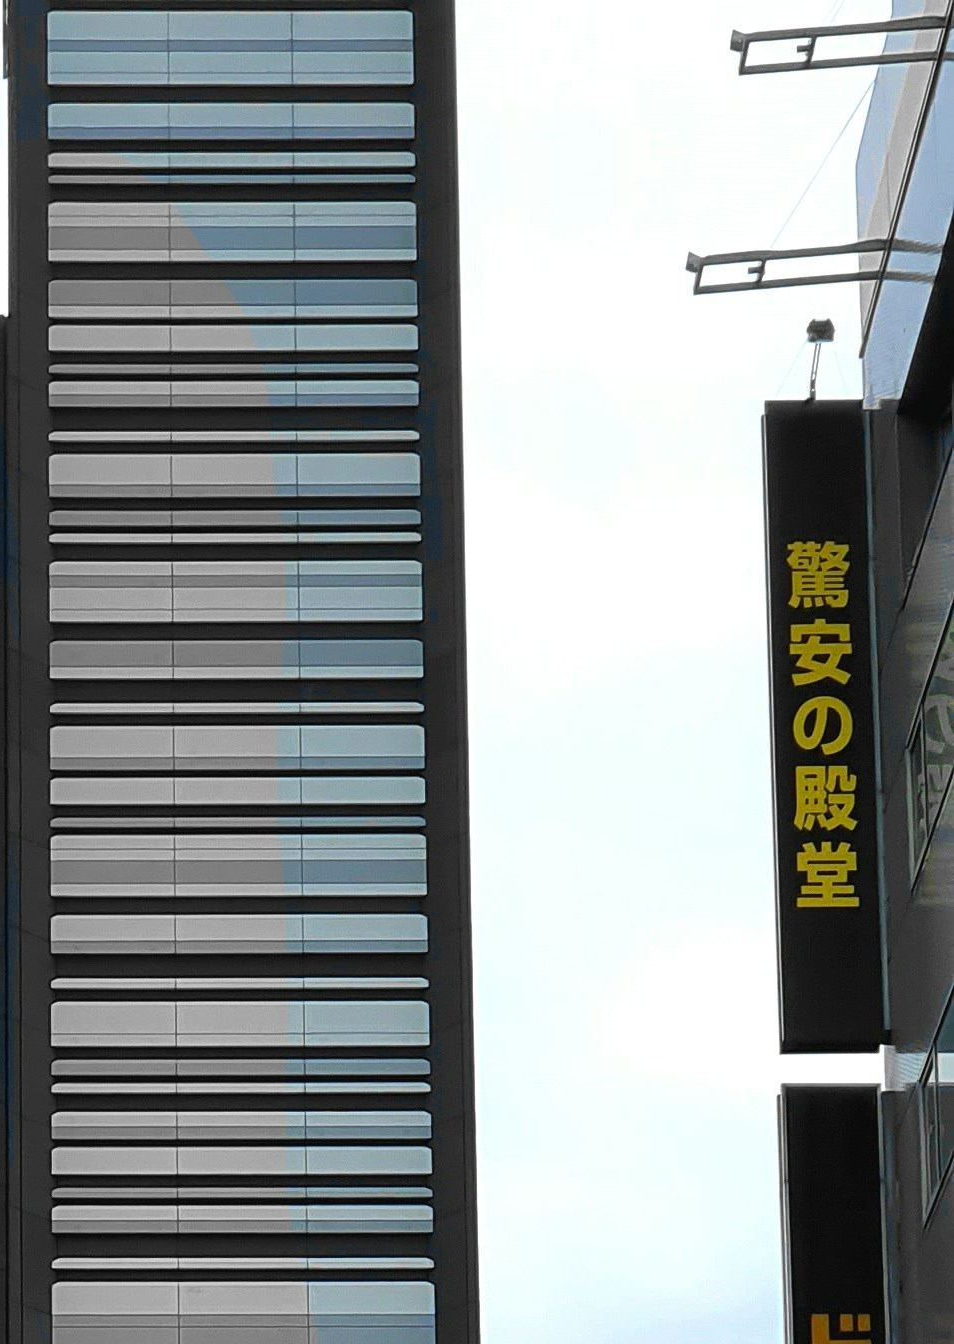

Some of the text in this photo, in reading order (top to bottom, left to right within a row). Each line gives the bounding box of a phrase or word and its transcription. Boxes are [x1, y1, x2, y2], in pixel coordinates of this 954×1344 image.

[787, 540, 859, 908] 驚安の殿堂
